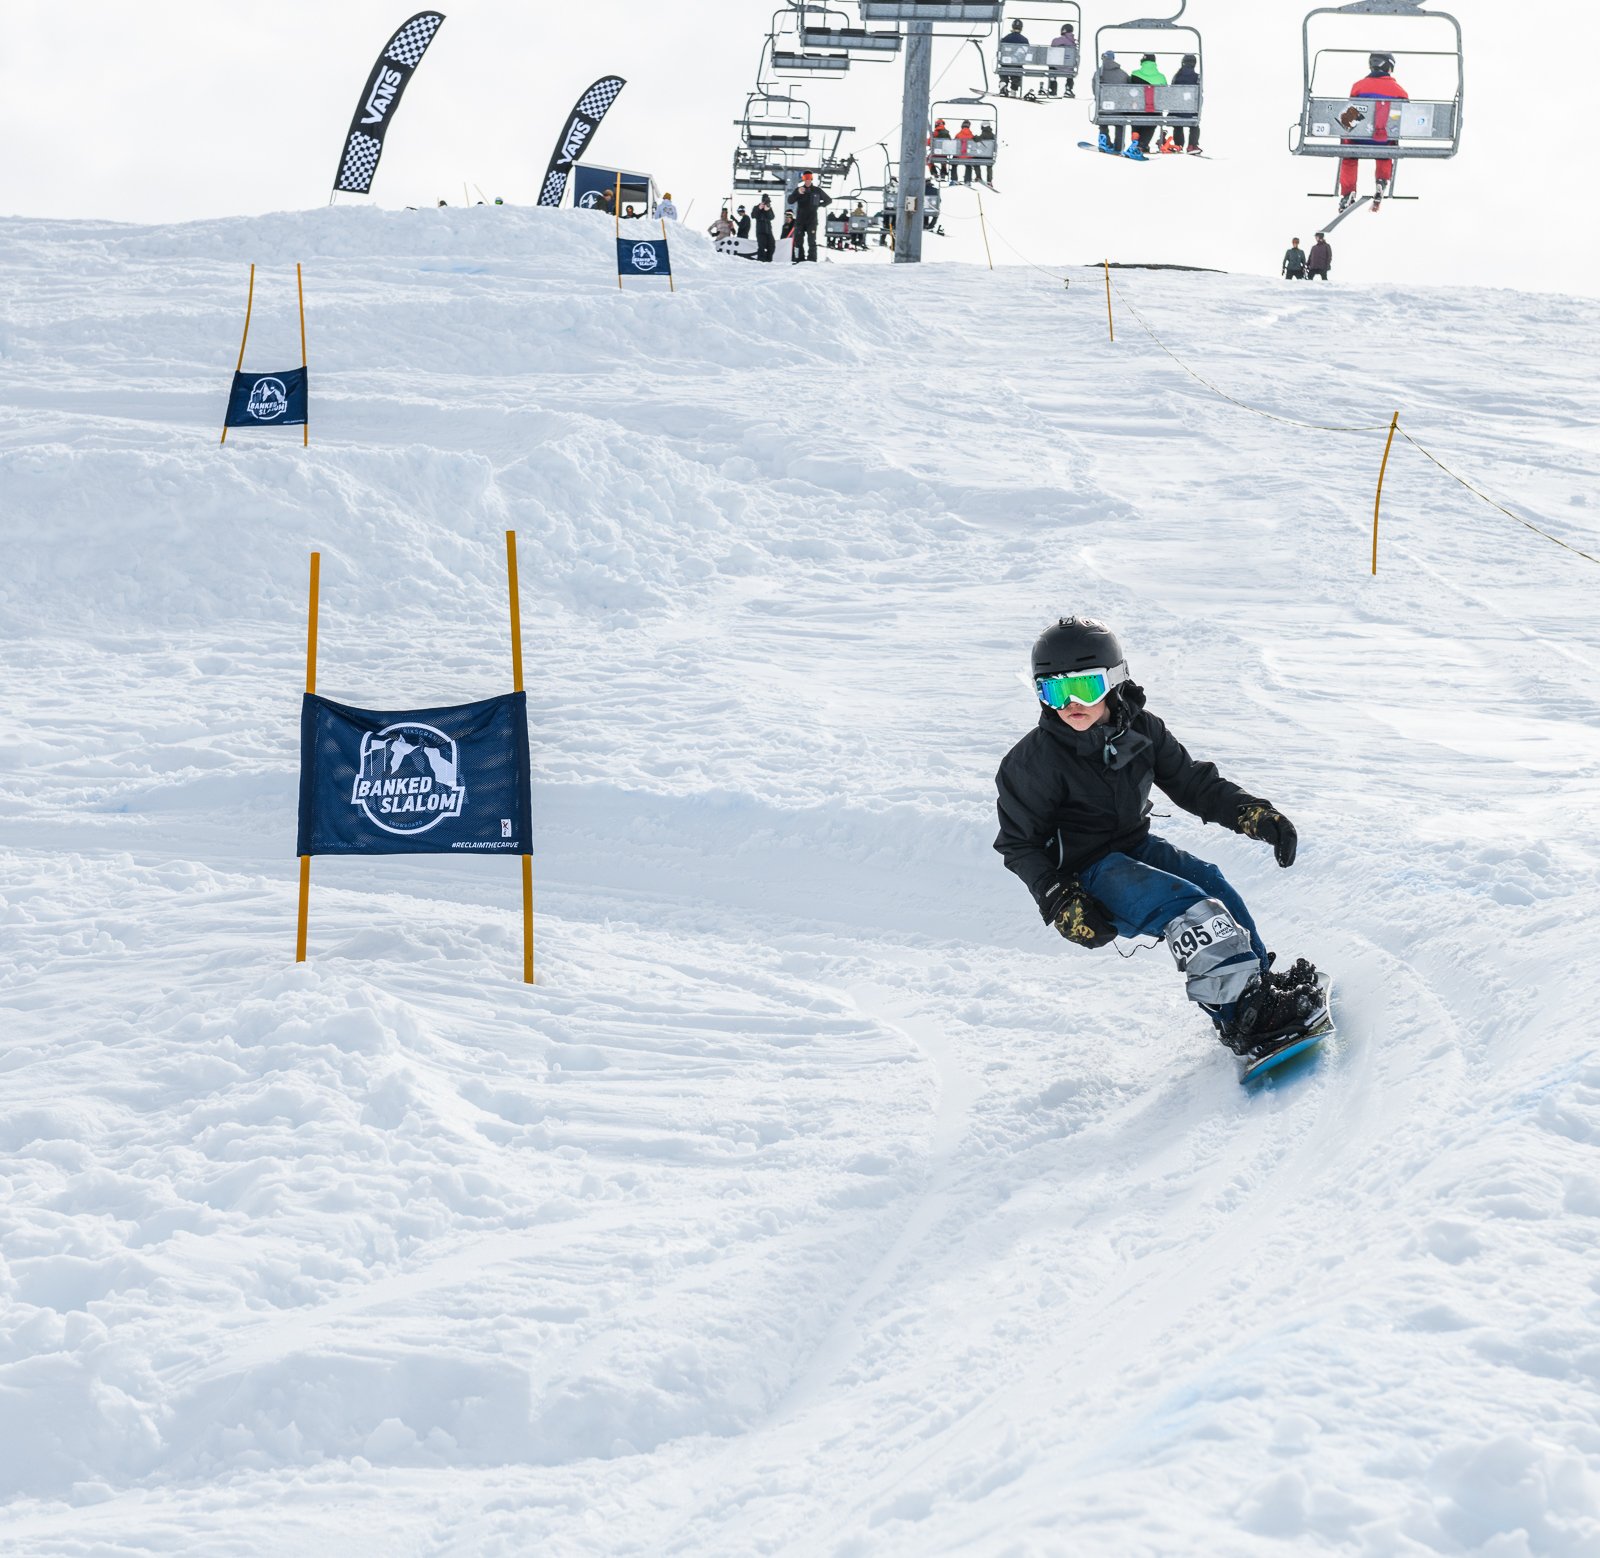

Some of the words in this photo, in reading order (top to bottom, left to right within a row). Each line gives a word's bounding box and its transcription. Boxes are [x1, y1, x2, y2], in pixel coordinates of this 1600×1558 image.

[360, 65, 402, 124] VANS
[556, 117, 591, 164] VANS
[358, 776, 432, 797] BANKED
[380, 793, 456, 813] SLALOM
[451, 841, 519, 849] #RECLAIMTHECARVE
[1172, 925, 1213, 959] 295
